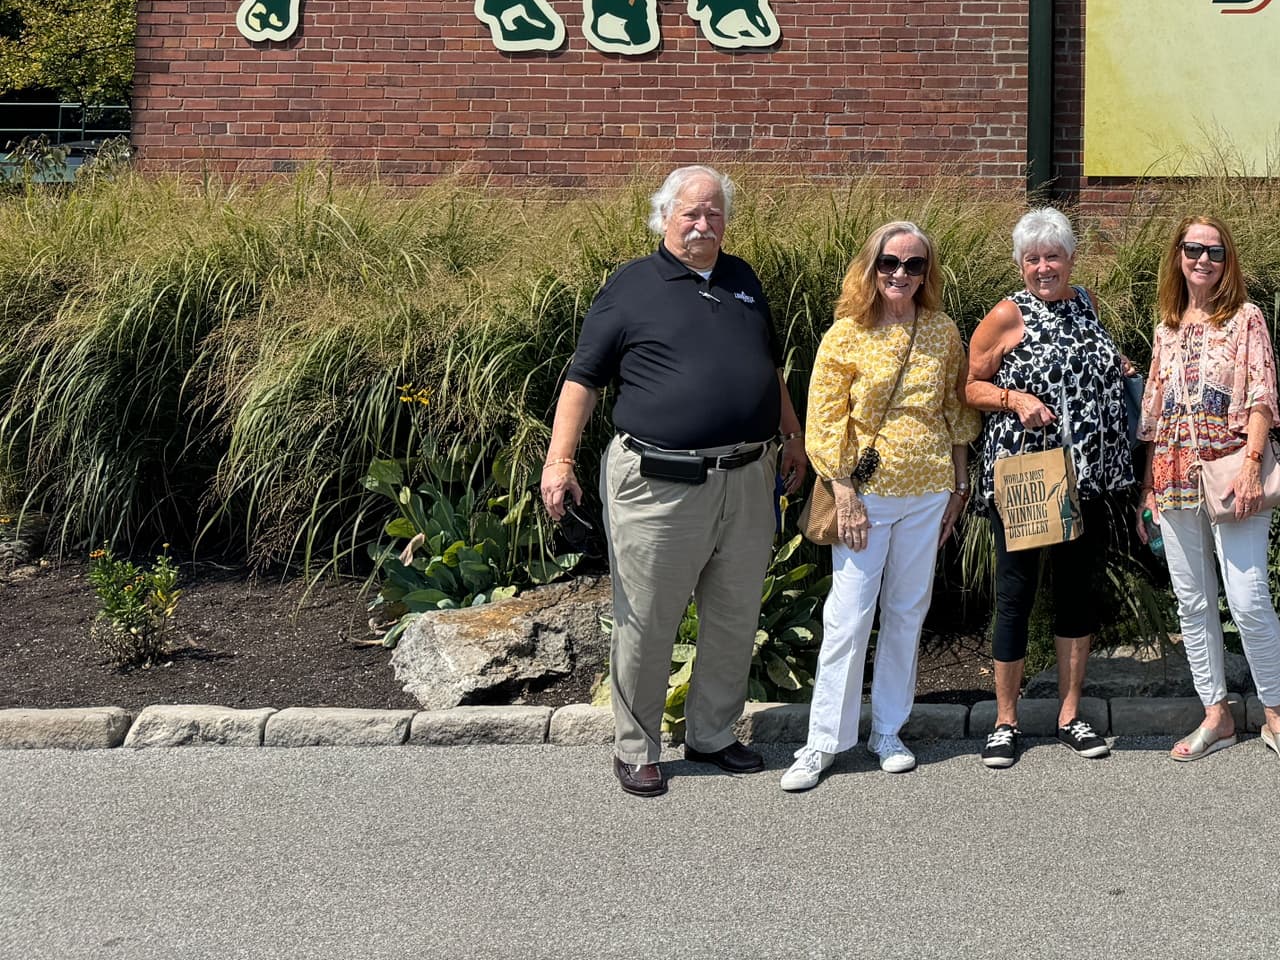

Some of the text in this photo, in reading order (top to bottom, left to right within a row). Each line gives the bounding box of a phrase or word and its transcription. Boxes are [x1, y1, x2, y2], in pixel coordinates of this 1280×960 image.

[1029, 469, 1044, 481] MOST
[1006, 480, 1046, 508] AWARD
[1007, 503, 1048, 525] WINNING
[1009, 520, 1049, 539] DISTILLERY
